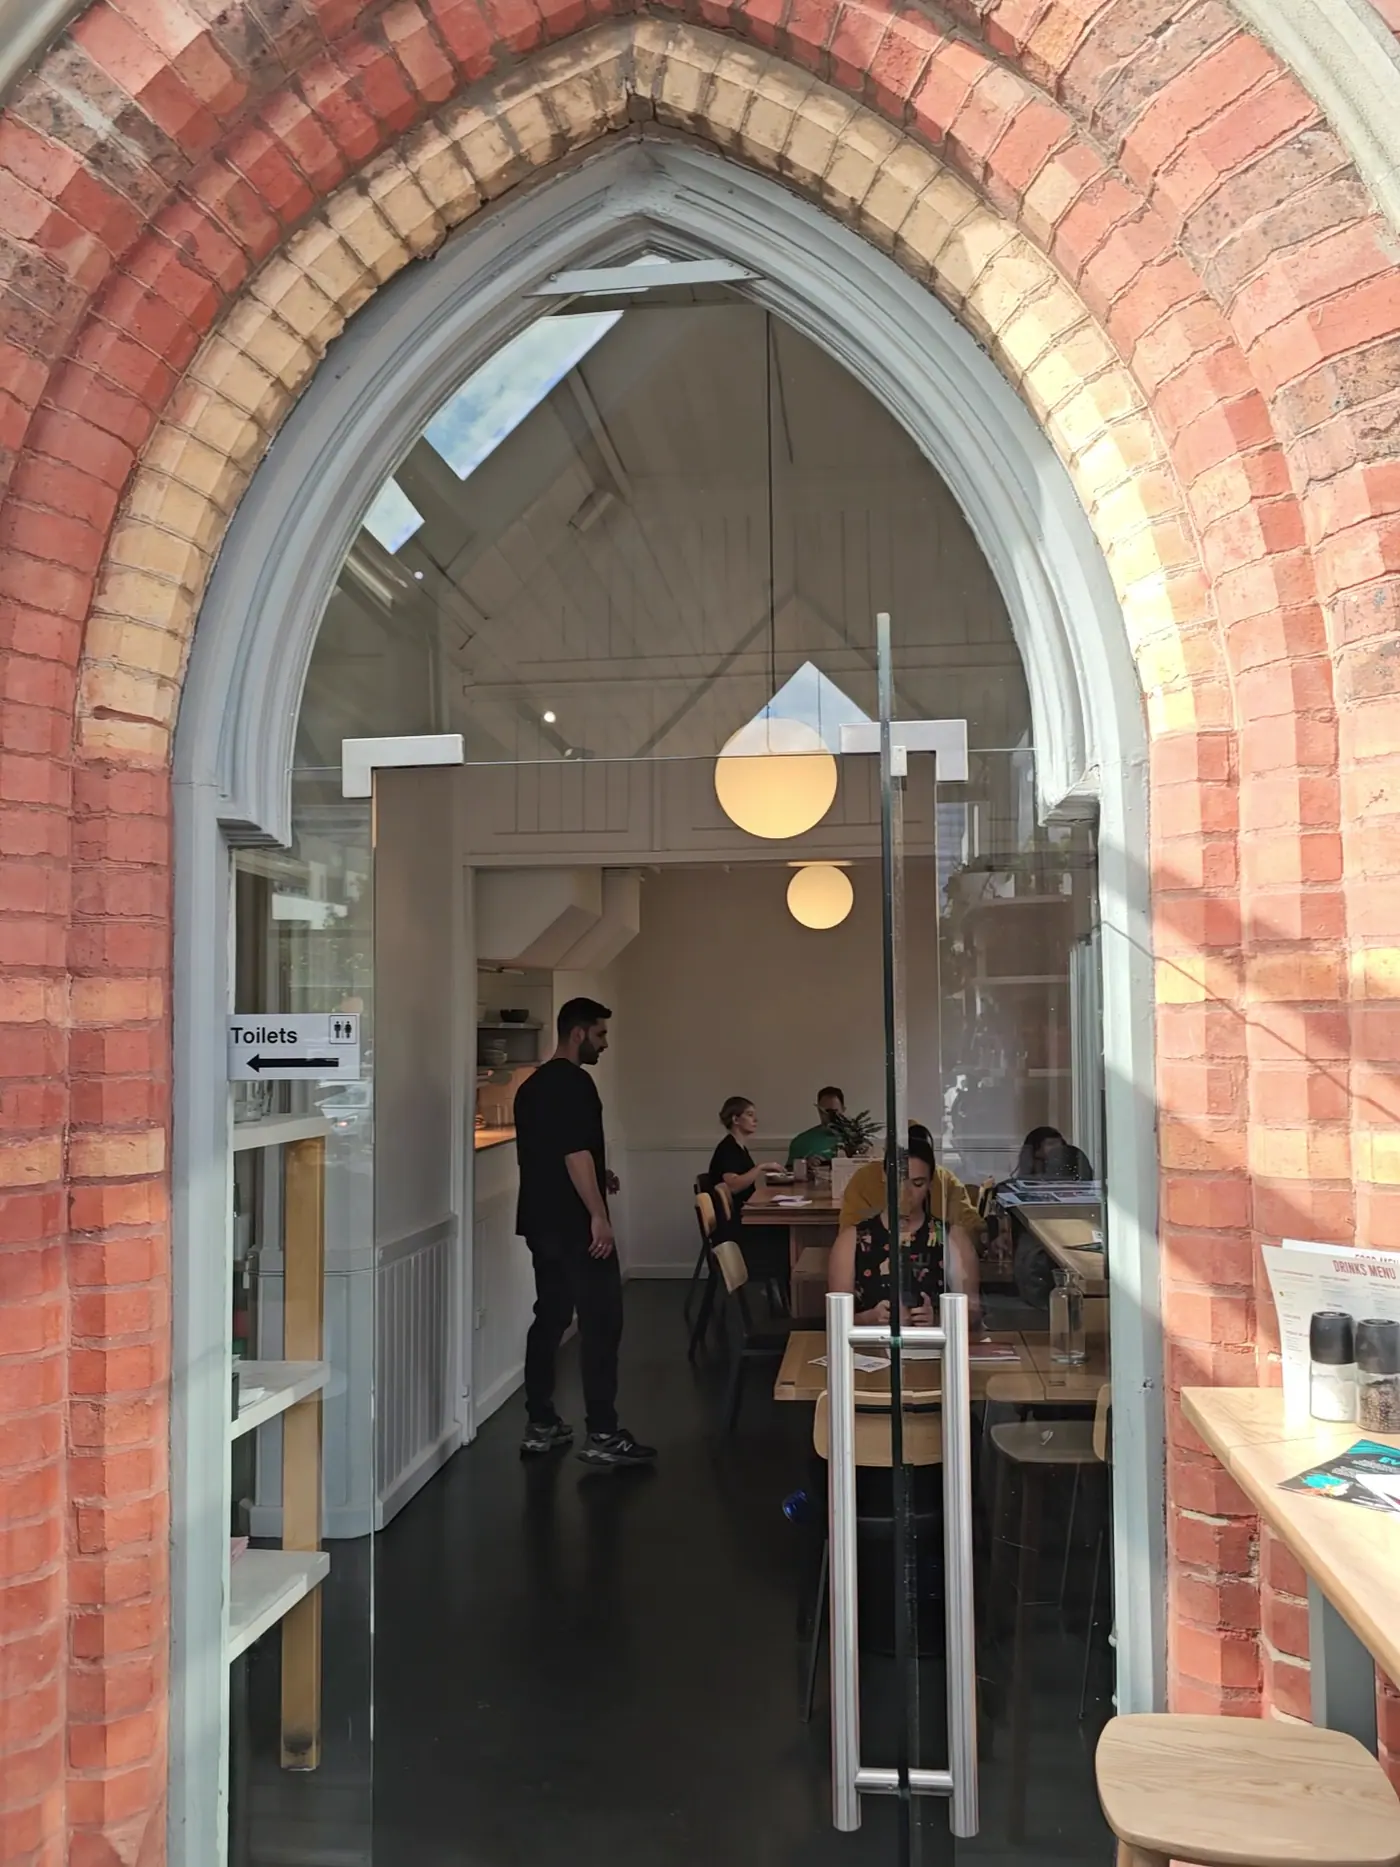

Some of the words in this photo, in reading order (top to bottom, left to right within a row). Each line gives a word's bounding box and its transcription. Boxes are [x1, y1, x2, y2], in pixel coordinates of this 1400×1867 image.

[230, 1027, 298, 1044] Toilets
[1332, 1259, 1367, 1276] DRINKS
[1367, 1264, 1397, 1280] MENU
